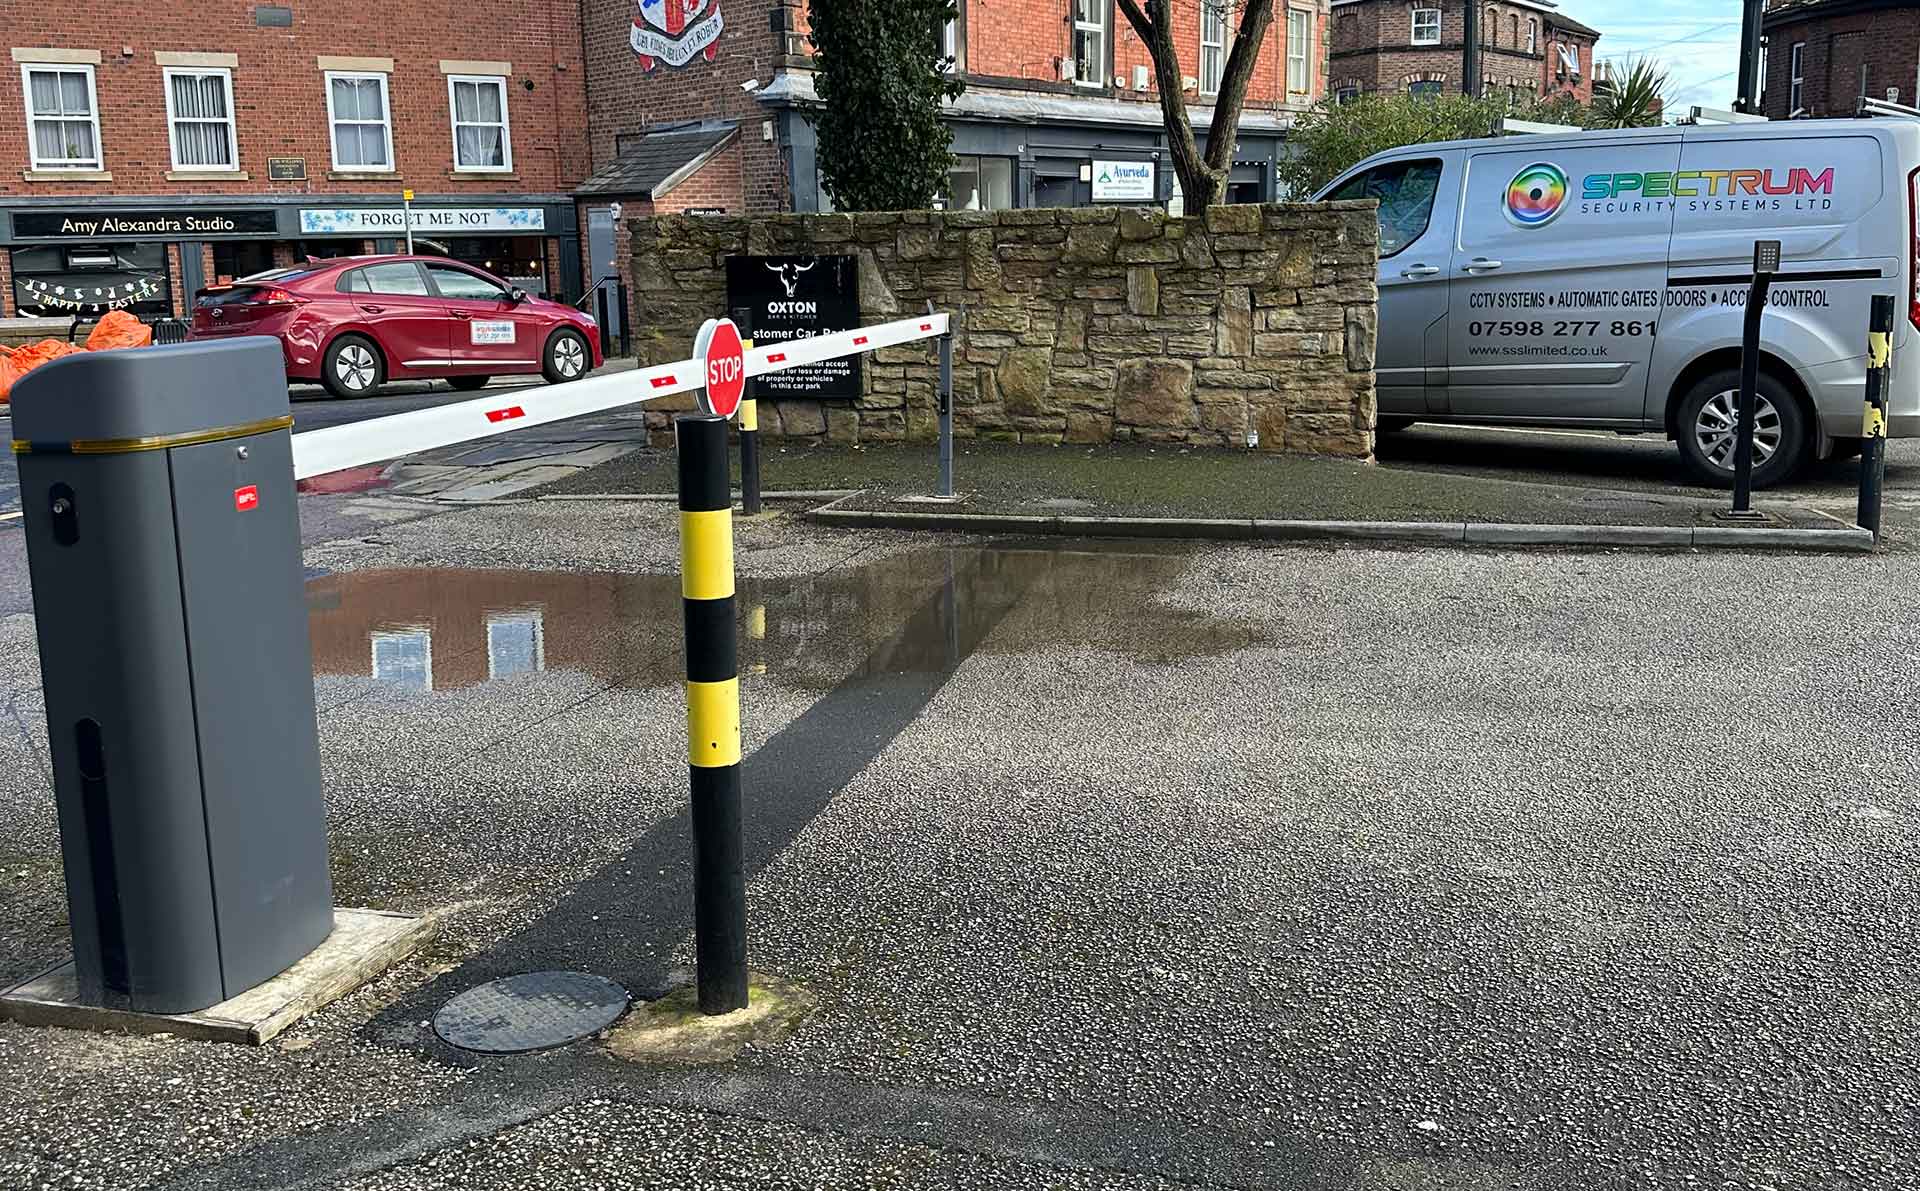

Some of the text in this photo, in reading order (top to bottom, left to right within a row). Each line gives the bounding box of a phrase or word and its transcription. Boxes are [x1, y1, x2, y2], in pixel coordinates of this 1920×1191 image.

[1114, 165, 1149, 178] Ayurveda
[1582, 168, 1834, 199] SPECTRUM
[1581, 199, 1832, 214] SECURITY SYSTEMS LTD
[361, 212, 490, 225] FORGET ME NOT
[61, 216, 235, 236] Amy Alexandra Studio
[44, 289, 152, 311] HAPPY EASTER
[1470, 292, 1497, 308] CCTV
[1499, 292, 1545, 308] SYSTEMS
[1557, 290, 1619, 307] AUTOMATIC
[1621, 290, 1658, 307] GATES
[1667, 290, 1707, 307] DOORS
[1771, 289, 1829, 307] CONTROL
[767, 302, 817, 313] OXTON
[753, 328, 793, 339] stomer
[796, 328, 816, 339] Car
[1469, 320, 1657, 337] 07598 277 861
[1469, 345, 1608, 357] www.ssslimited.co.uk
[710, 356, 742, 385] STOP
[823, 367, 851, 376] damage
[825, 361, 849, 369] accept
